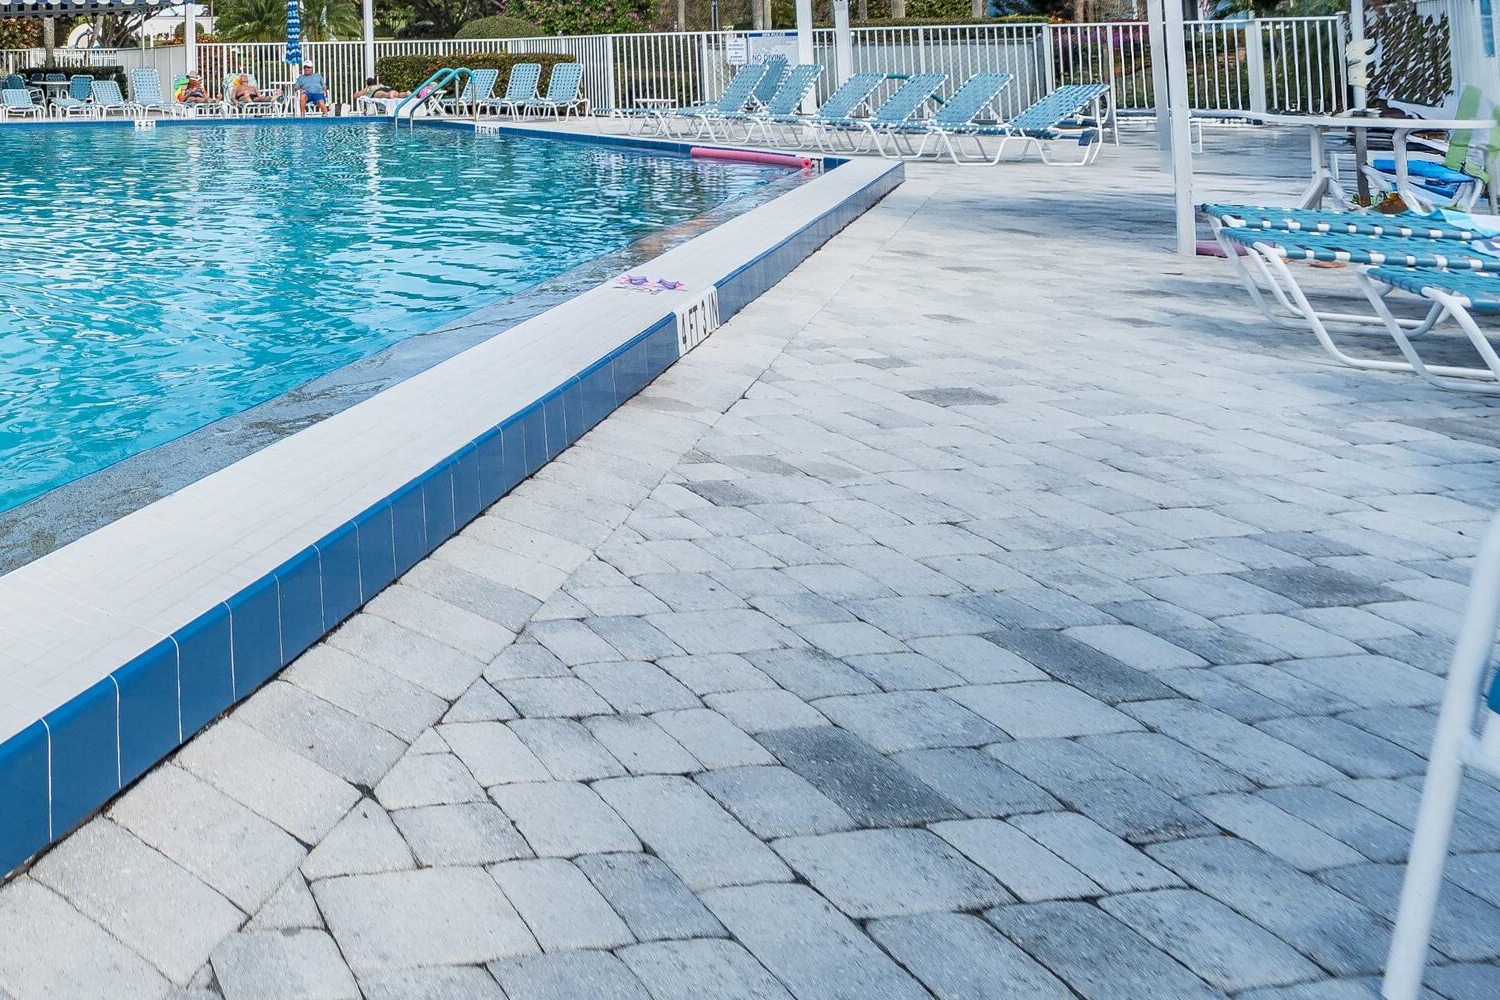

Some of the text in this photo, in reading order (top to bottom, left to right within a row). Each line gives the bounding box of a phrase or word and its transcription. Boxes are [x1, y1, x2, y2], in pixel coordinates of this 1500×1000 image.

[681, 290, 718, 350] 4 FT 3 IN
